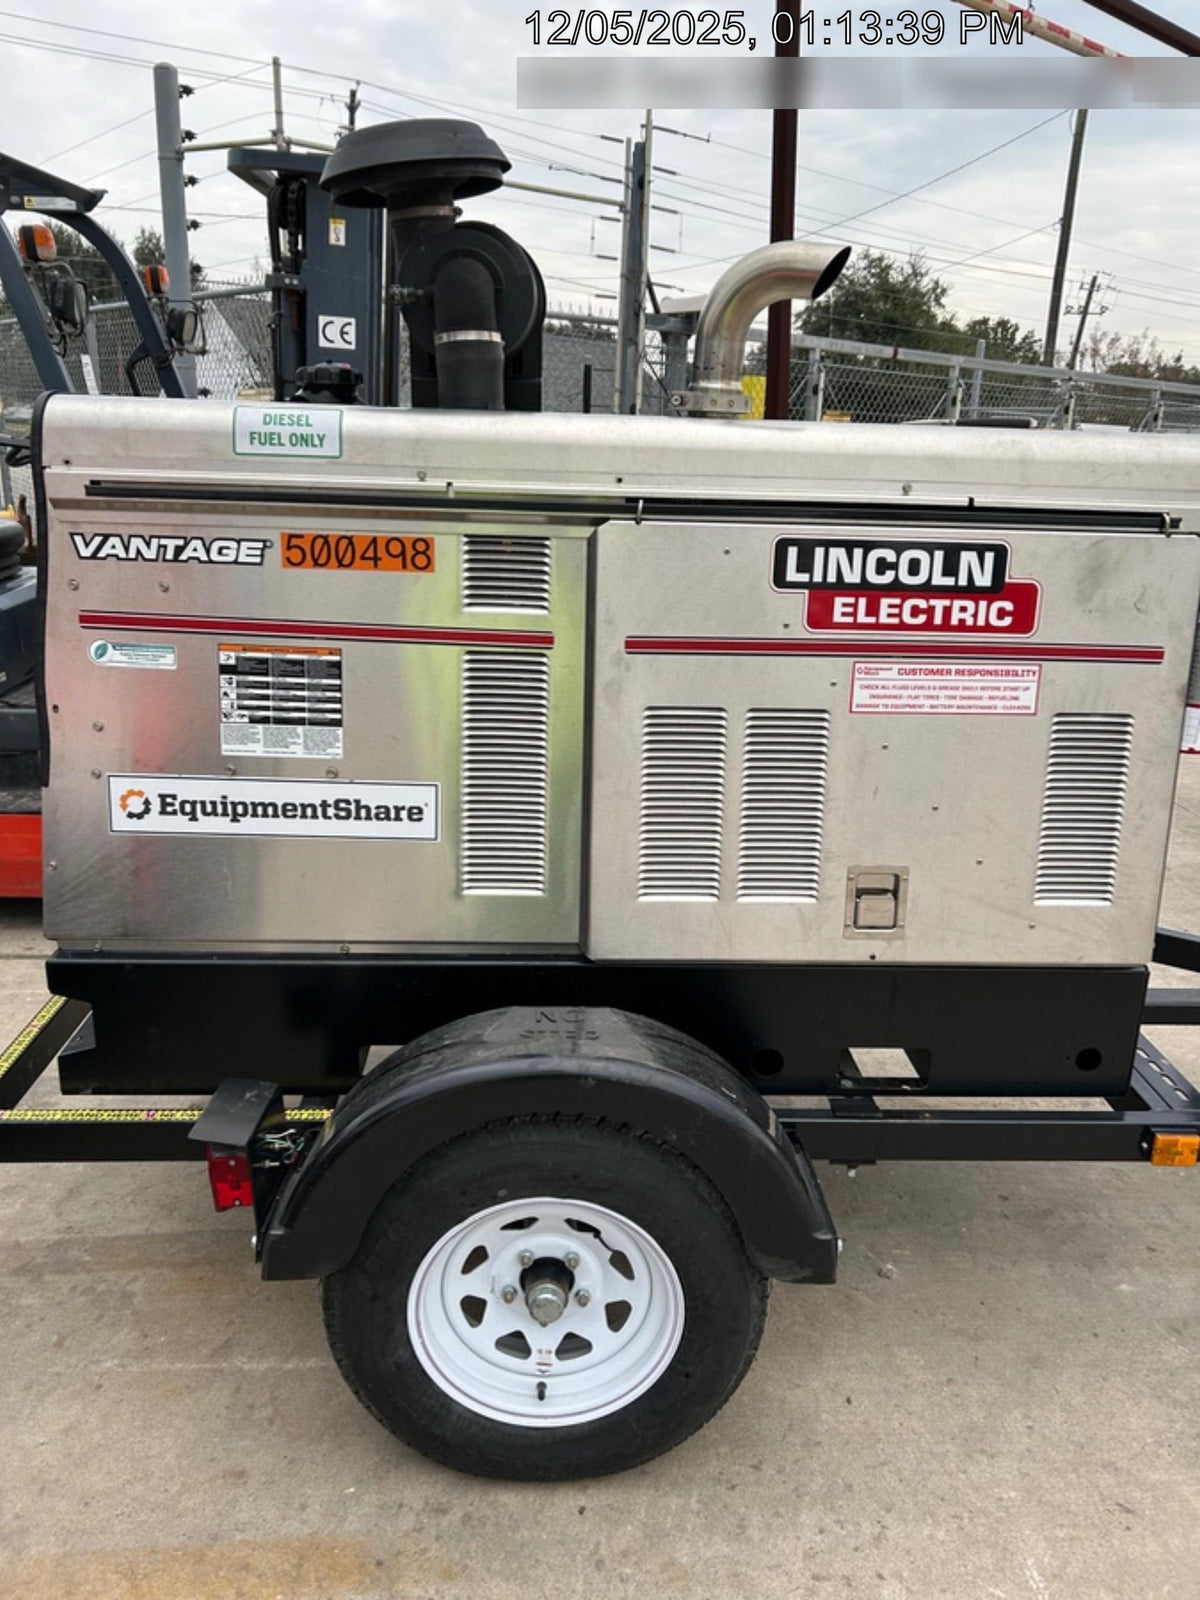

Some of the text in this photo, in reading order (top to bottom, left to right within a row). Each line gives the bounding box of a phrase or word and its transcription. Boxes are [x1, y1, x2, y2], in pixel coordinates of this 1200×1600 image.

[262, 413, 313, 427] DIESEL
[249, 431, 326, 448] FUEL ONLY
[284, 533, 433, 570] 500498
[785, 545, 995, 587] LINCOLN
[832, 596, 1014, 627] ELECTRIC
[897, 667, 952, 677] CUSTOMER
[954, 667, 1037, 678] RESPONSIBILITY
[157, 792, 425, 823] EquipmentShare
